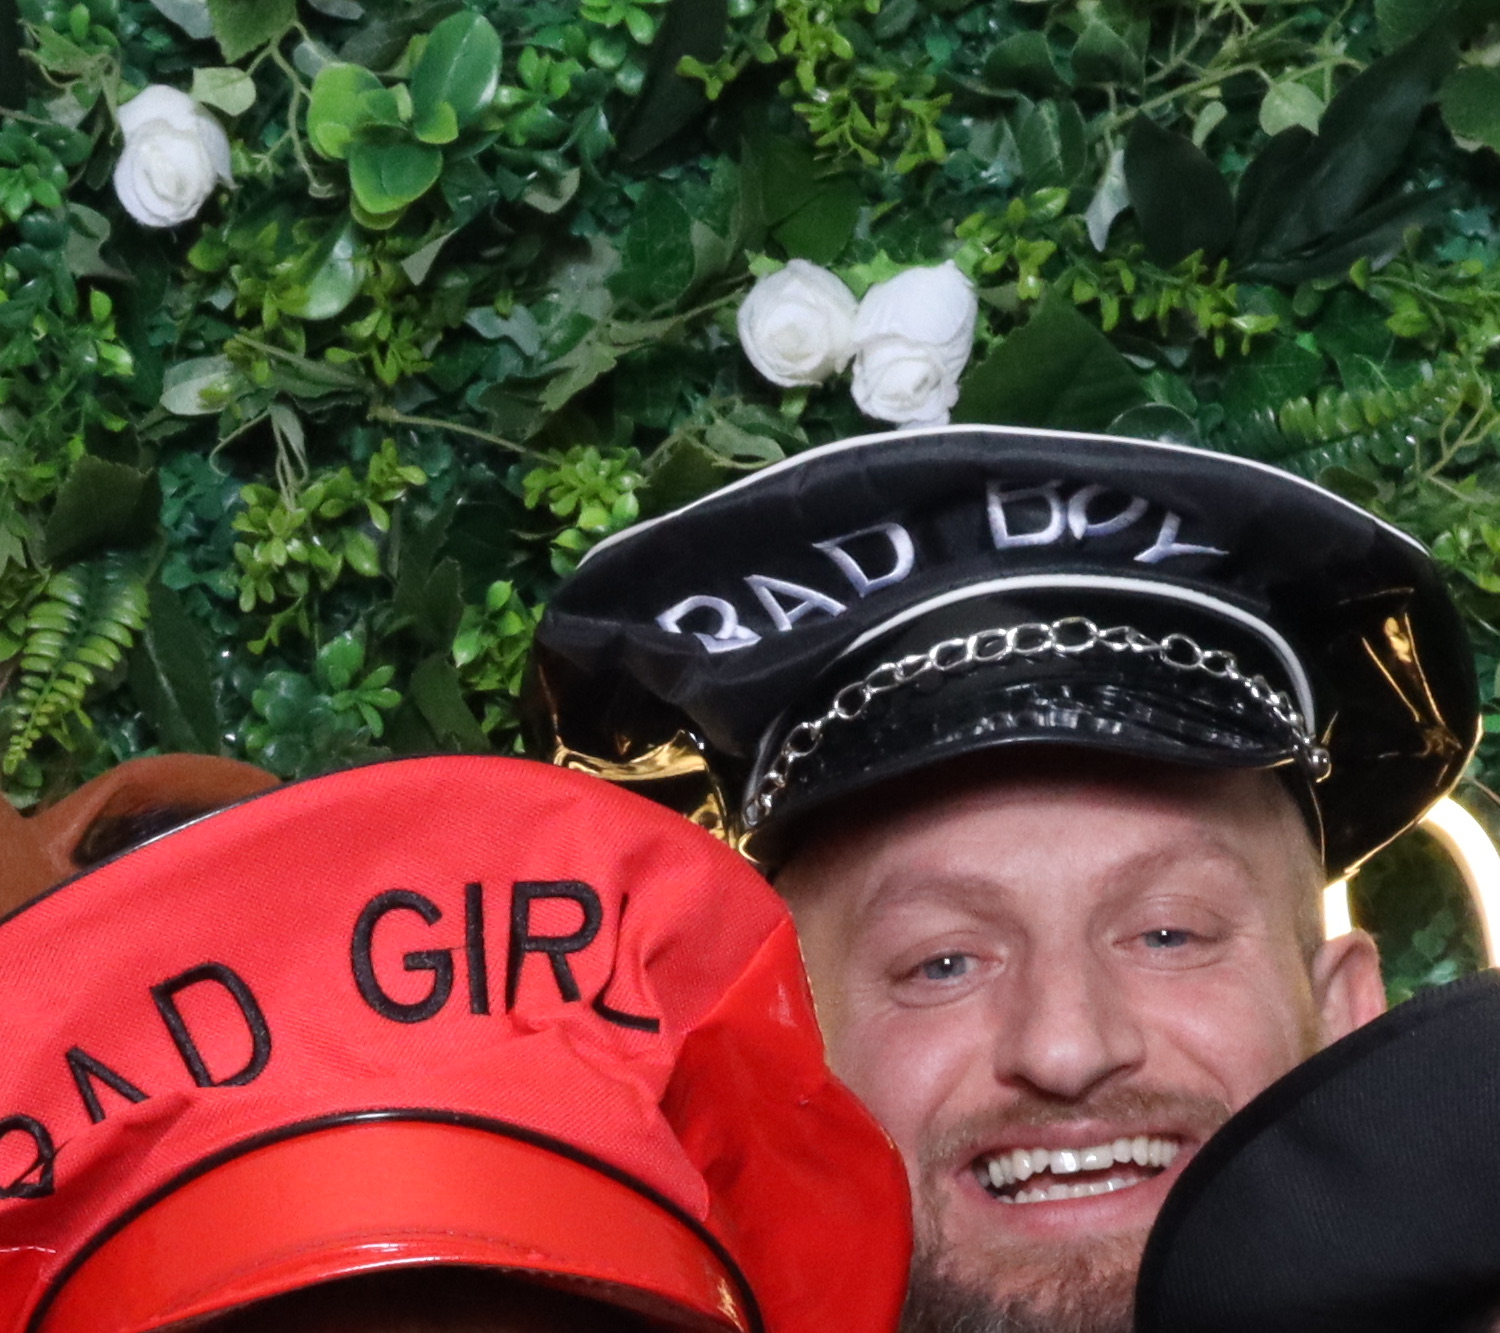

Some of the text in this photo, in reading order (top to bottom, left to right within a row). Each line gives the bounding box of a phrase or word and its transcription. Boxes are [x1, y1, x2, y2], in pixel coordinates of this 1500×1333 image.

[655, 477, 1231, 654] BAD BOY
[349, 880, 661, 1034] GIRL
